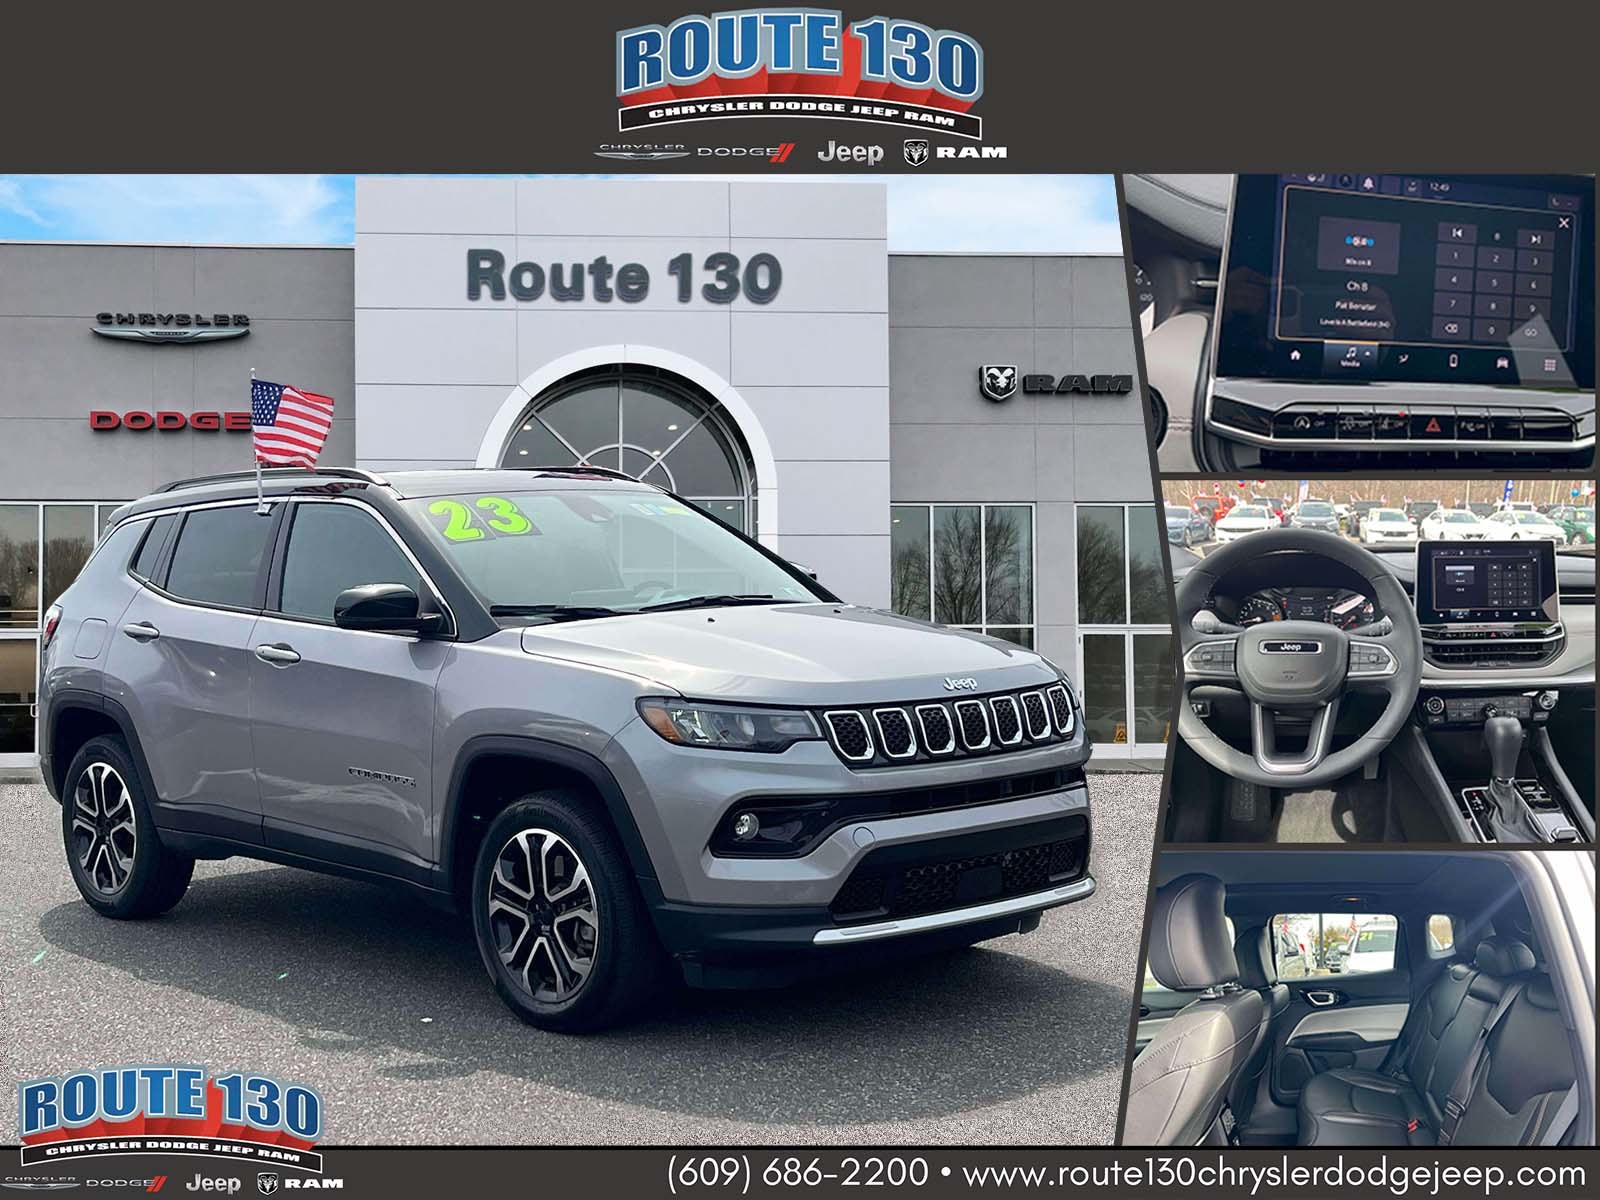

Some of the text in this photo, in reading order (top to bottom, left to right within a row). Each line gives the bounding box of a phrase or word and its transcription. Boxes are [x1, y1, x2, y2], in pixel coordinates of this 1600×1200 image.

[466, 248, 783, 304] Route 130
[95, 311, 250, 327] CHRYSLER
[1022, 373, 1133, 396] RAM
[89, 410, 252, 431] DODGE
[428, 495, 534, 542] 23
[1280, 642, 1302, 652] Jeep
[943, 676, 979, 692] Jeep
